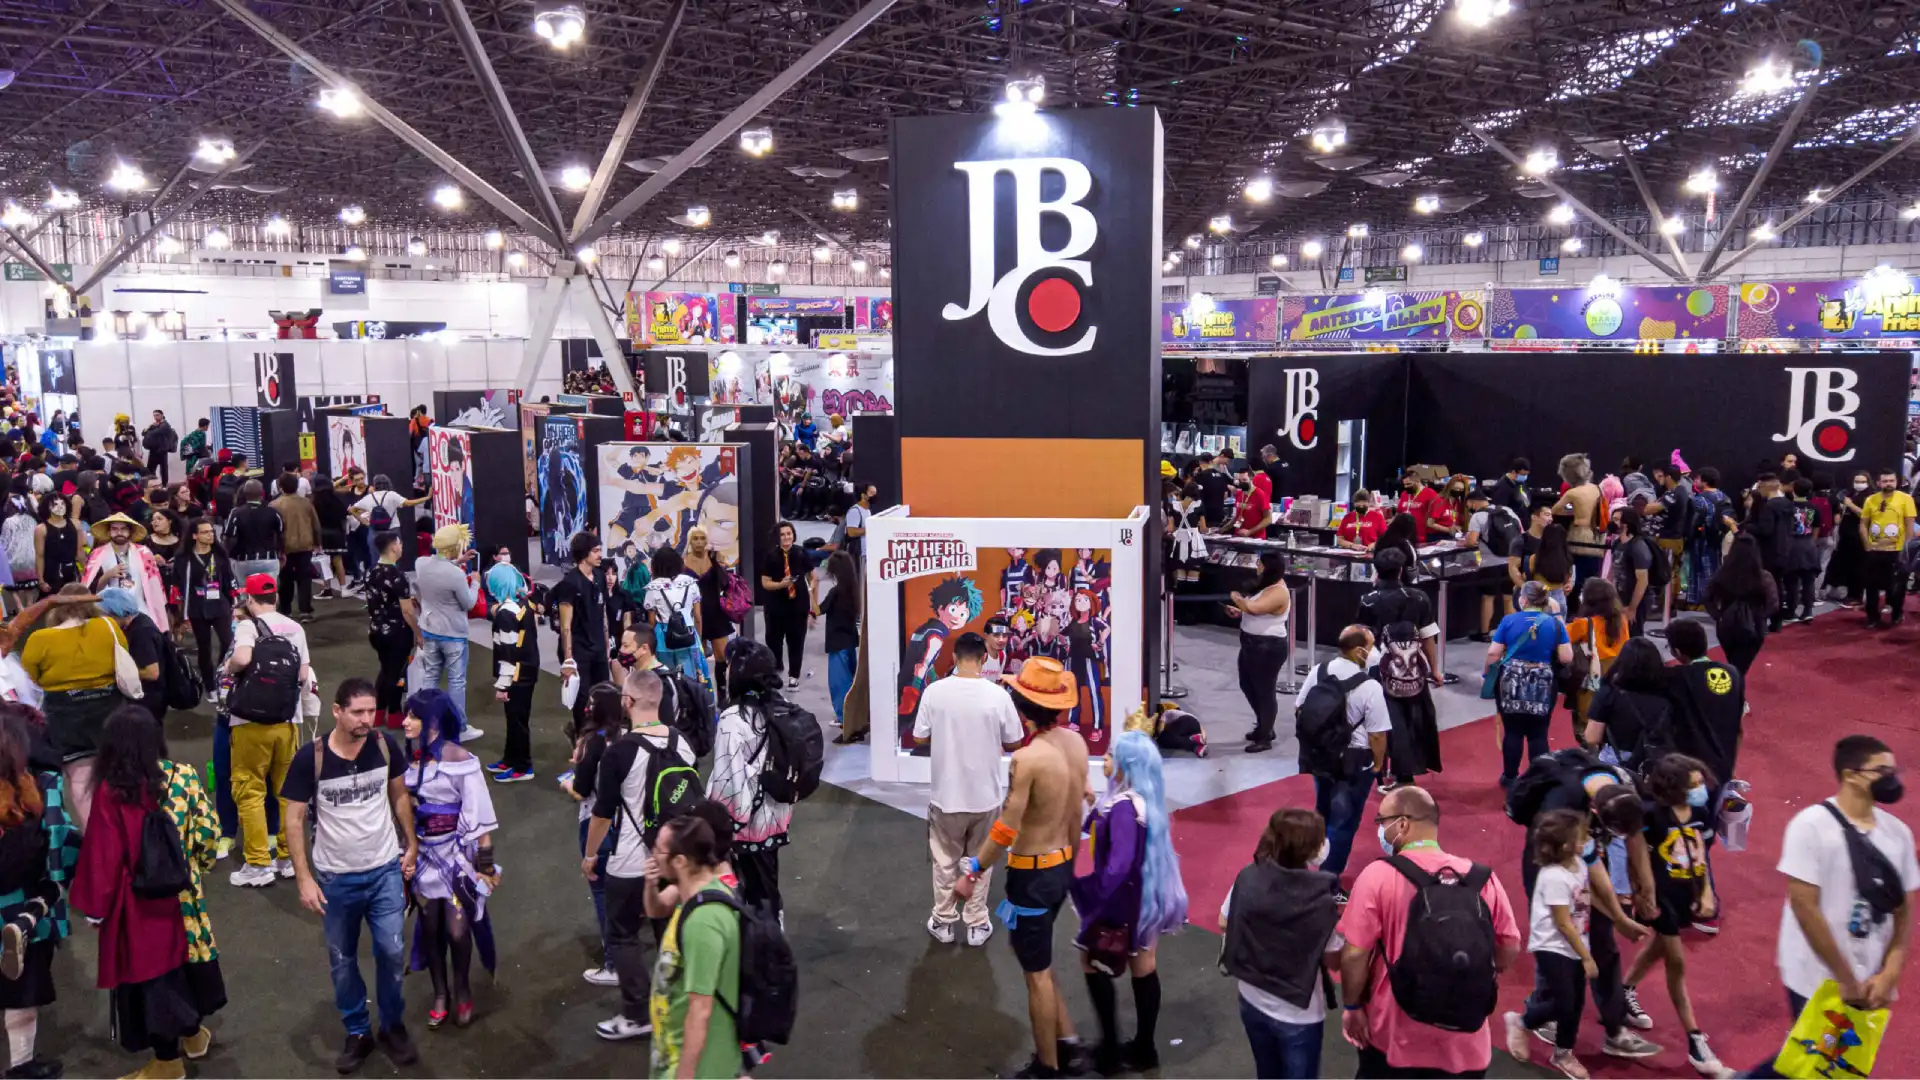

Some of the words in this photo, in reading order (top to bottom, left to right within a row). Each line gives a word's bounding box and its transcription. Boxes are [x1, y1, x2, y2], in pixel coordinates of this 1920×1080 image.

[942, 157, 1098, 356] JBC
[1309, 304, 1382, 332] ARTIST'S
[1386, 304, 1442, 329] ALLEY
[665, 356, 687, 412] JBC
[1277, 368, 1320, 450] JBC
[1772, 367, 1860, 462] JBC
[880, 554, 972, 580] ACADEMIA
[888, 540, 918, 559] MY
[918, 540, 967, 556] HERO
[669, 778, 688, 804] adidas
